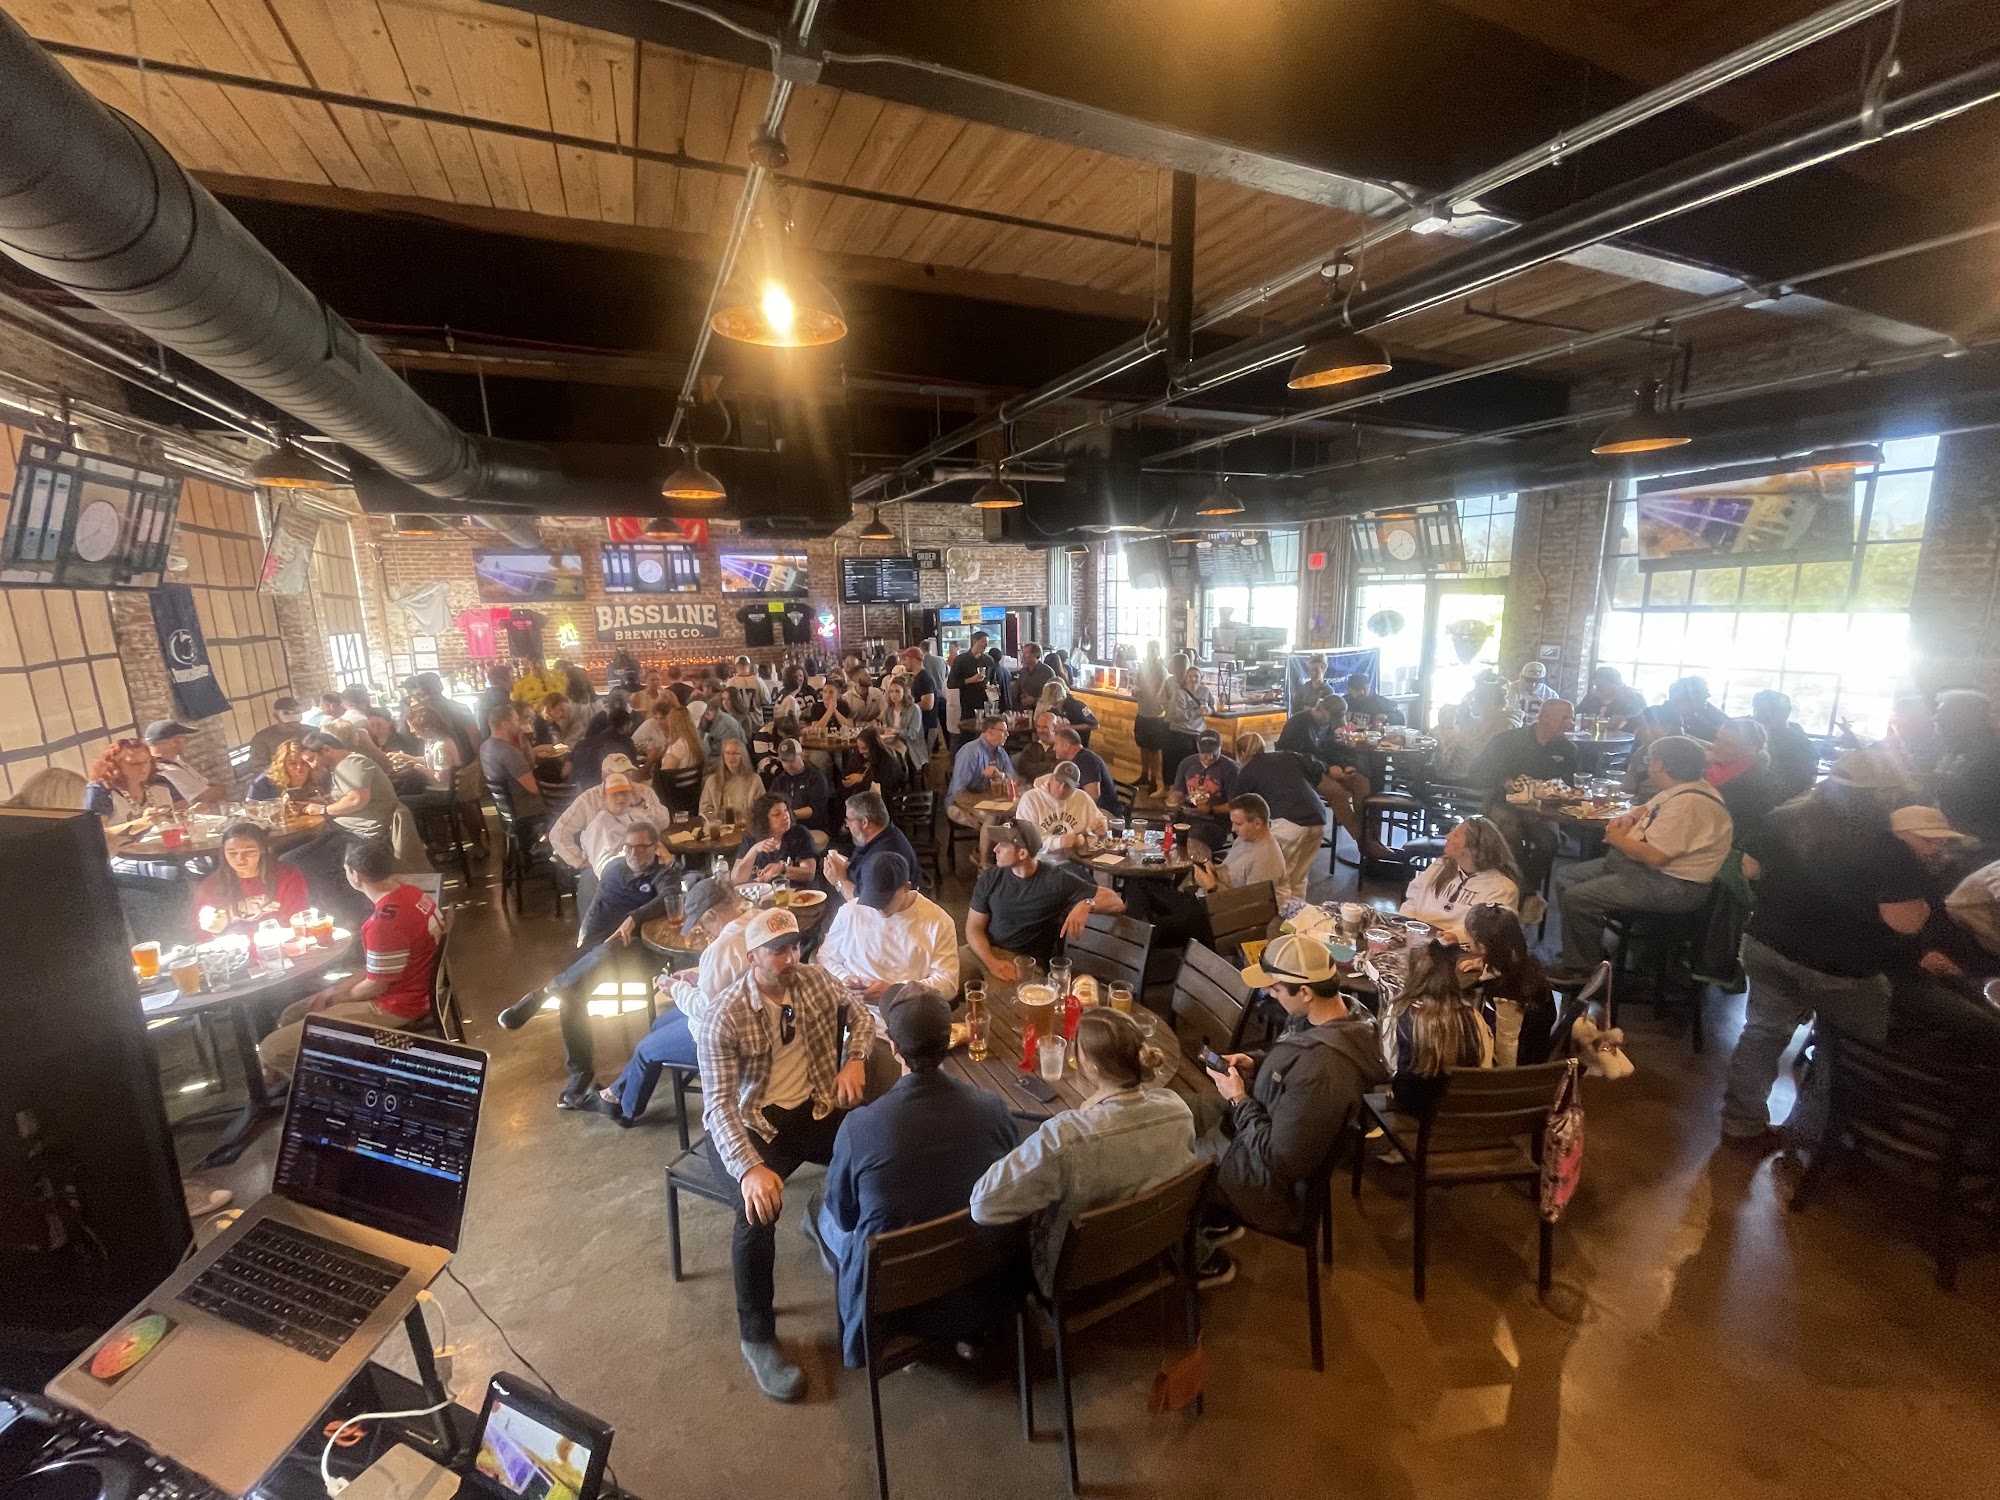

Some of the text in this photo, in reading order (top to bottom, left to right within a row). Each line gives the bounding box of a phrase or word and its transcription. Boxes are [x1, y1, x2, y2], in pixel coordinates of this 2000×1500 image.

[916, 552, 937, 561] ORDER
[920, 560, 934, 569] HERE
[595, 604, 719, 632] BASSLINE
[614, 628, 705, 641] BREWING CO.
[1040, 811, 1078, 831] PENN STATE
